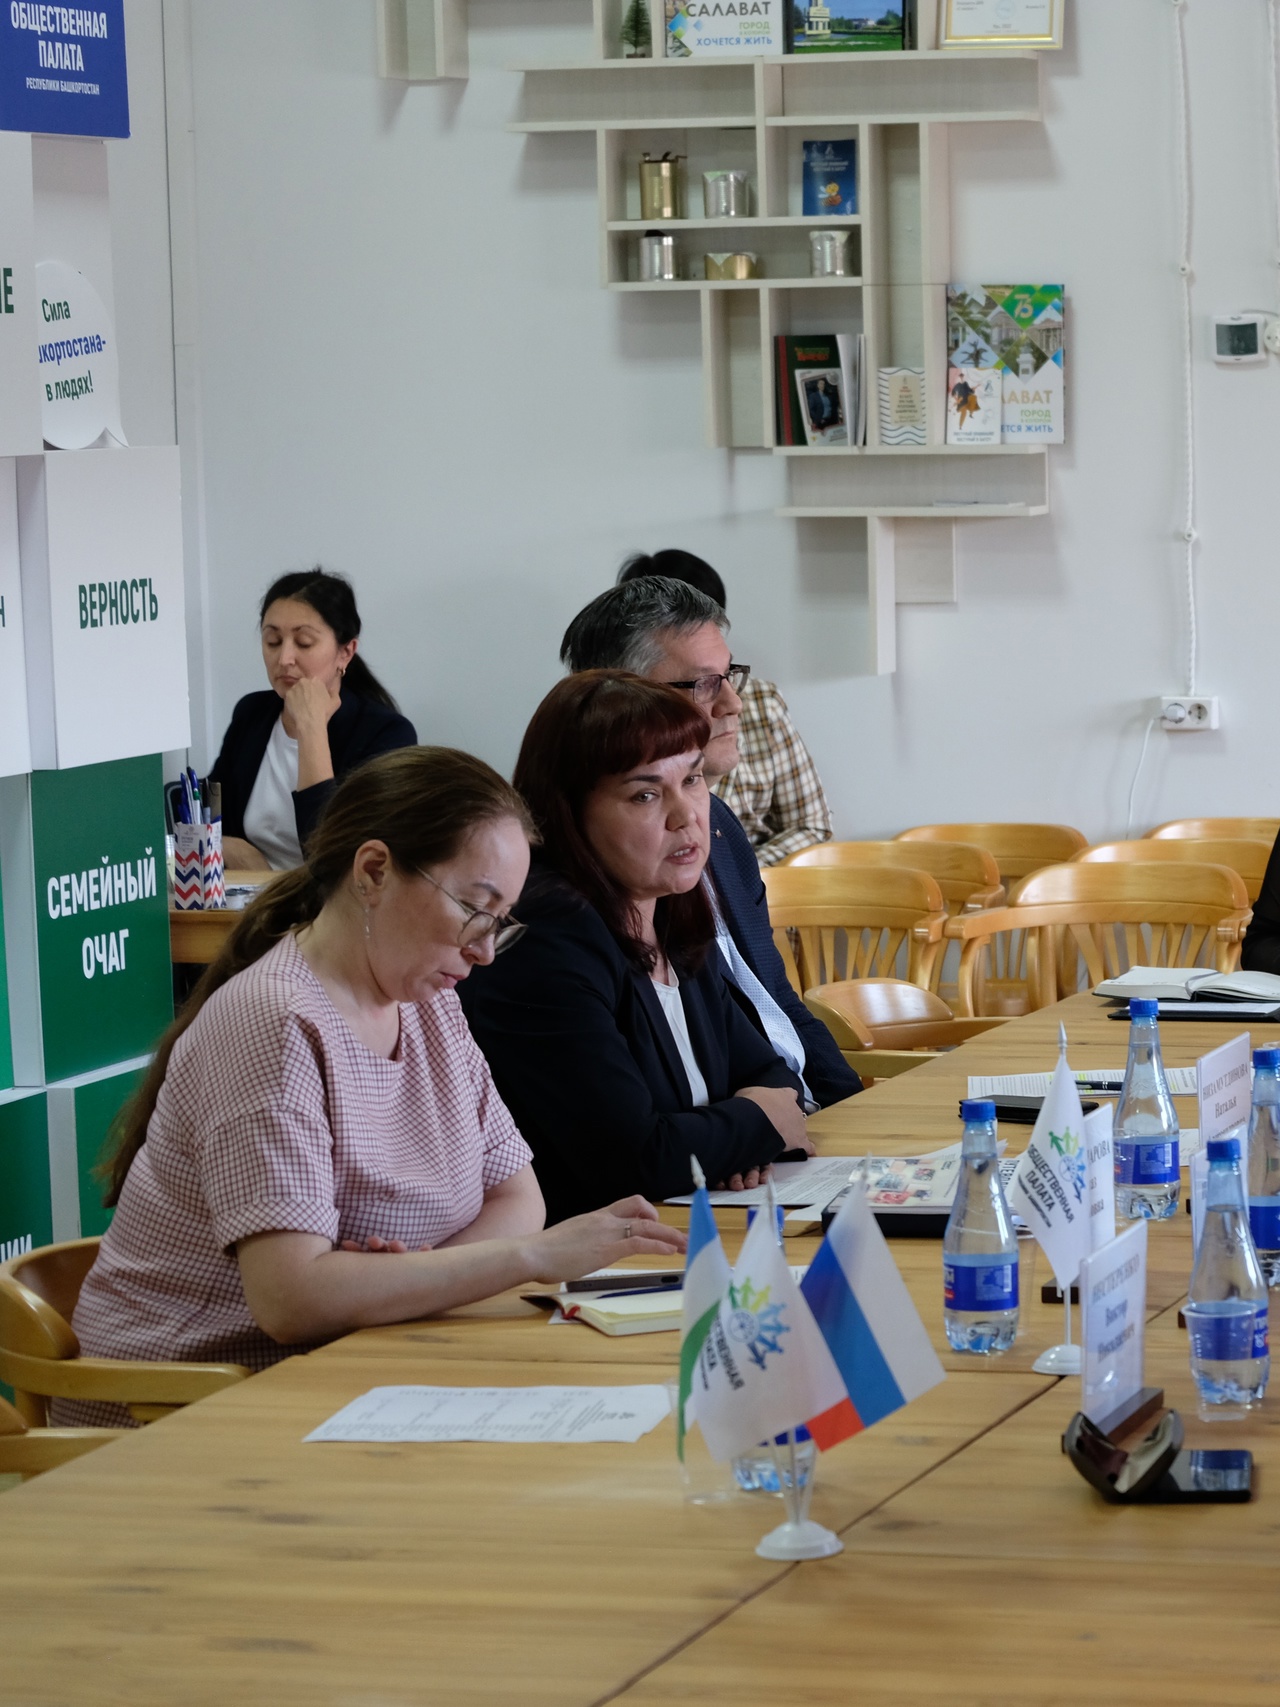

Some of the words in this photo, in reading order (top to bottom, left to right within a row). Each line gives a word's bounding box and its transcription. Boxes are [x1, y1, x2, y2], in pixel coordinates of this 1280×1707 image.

[11, 1, 107, 39] ОБЩЕСТВЕННАЯ
[685, 1, 771, 17] САЛАВАТ
[696, 37, 741, 46] ХОЧЕТСЯ
[744, 36, 772, 45] ЖИТЬ
[739, 21, 770, 30] ГОРОД
[38, 40, 84, 72] ПАЛАТА
[26, 77, 60, 92] РЕСПУБЛИКИ
[60, 80, 100, 95] БАШКОРТОСТАН
[0, 268, 14, 313] Е
[42, 298, 71, 323] Сила
[39, 334, 106, 366] кортостана-
[45, 383, 53, 401] в
[55, 370, 94, 401] людях!
[1001, 390, 1053, 405] АВАТ
[1001, 424, 1022, 433] ЕТСЯ
[1025, 424, 1053, 433] ЖИТЬ
[1020, 409, 1052, 418] ГОРОД
[78, 577, 158, 629] ВЕРНОСТЬ
[47, 846, 157, 919] СЕМЕЙНЫЙ
[82, 928, 129, 979] ОЧАГ
[1025, 1170, 1056, 1213] ПАЛАТА
[1028, 1143, 1075, 1225] ОБЩЕСТВЕННАЯ
